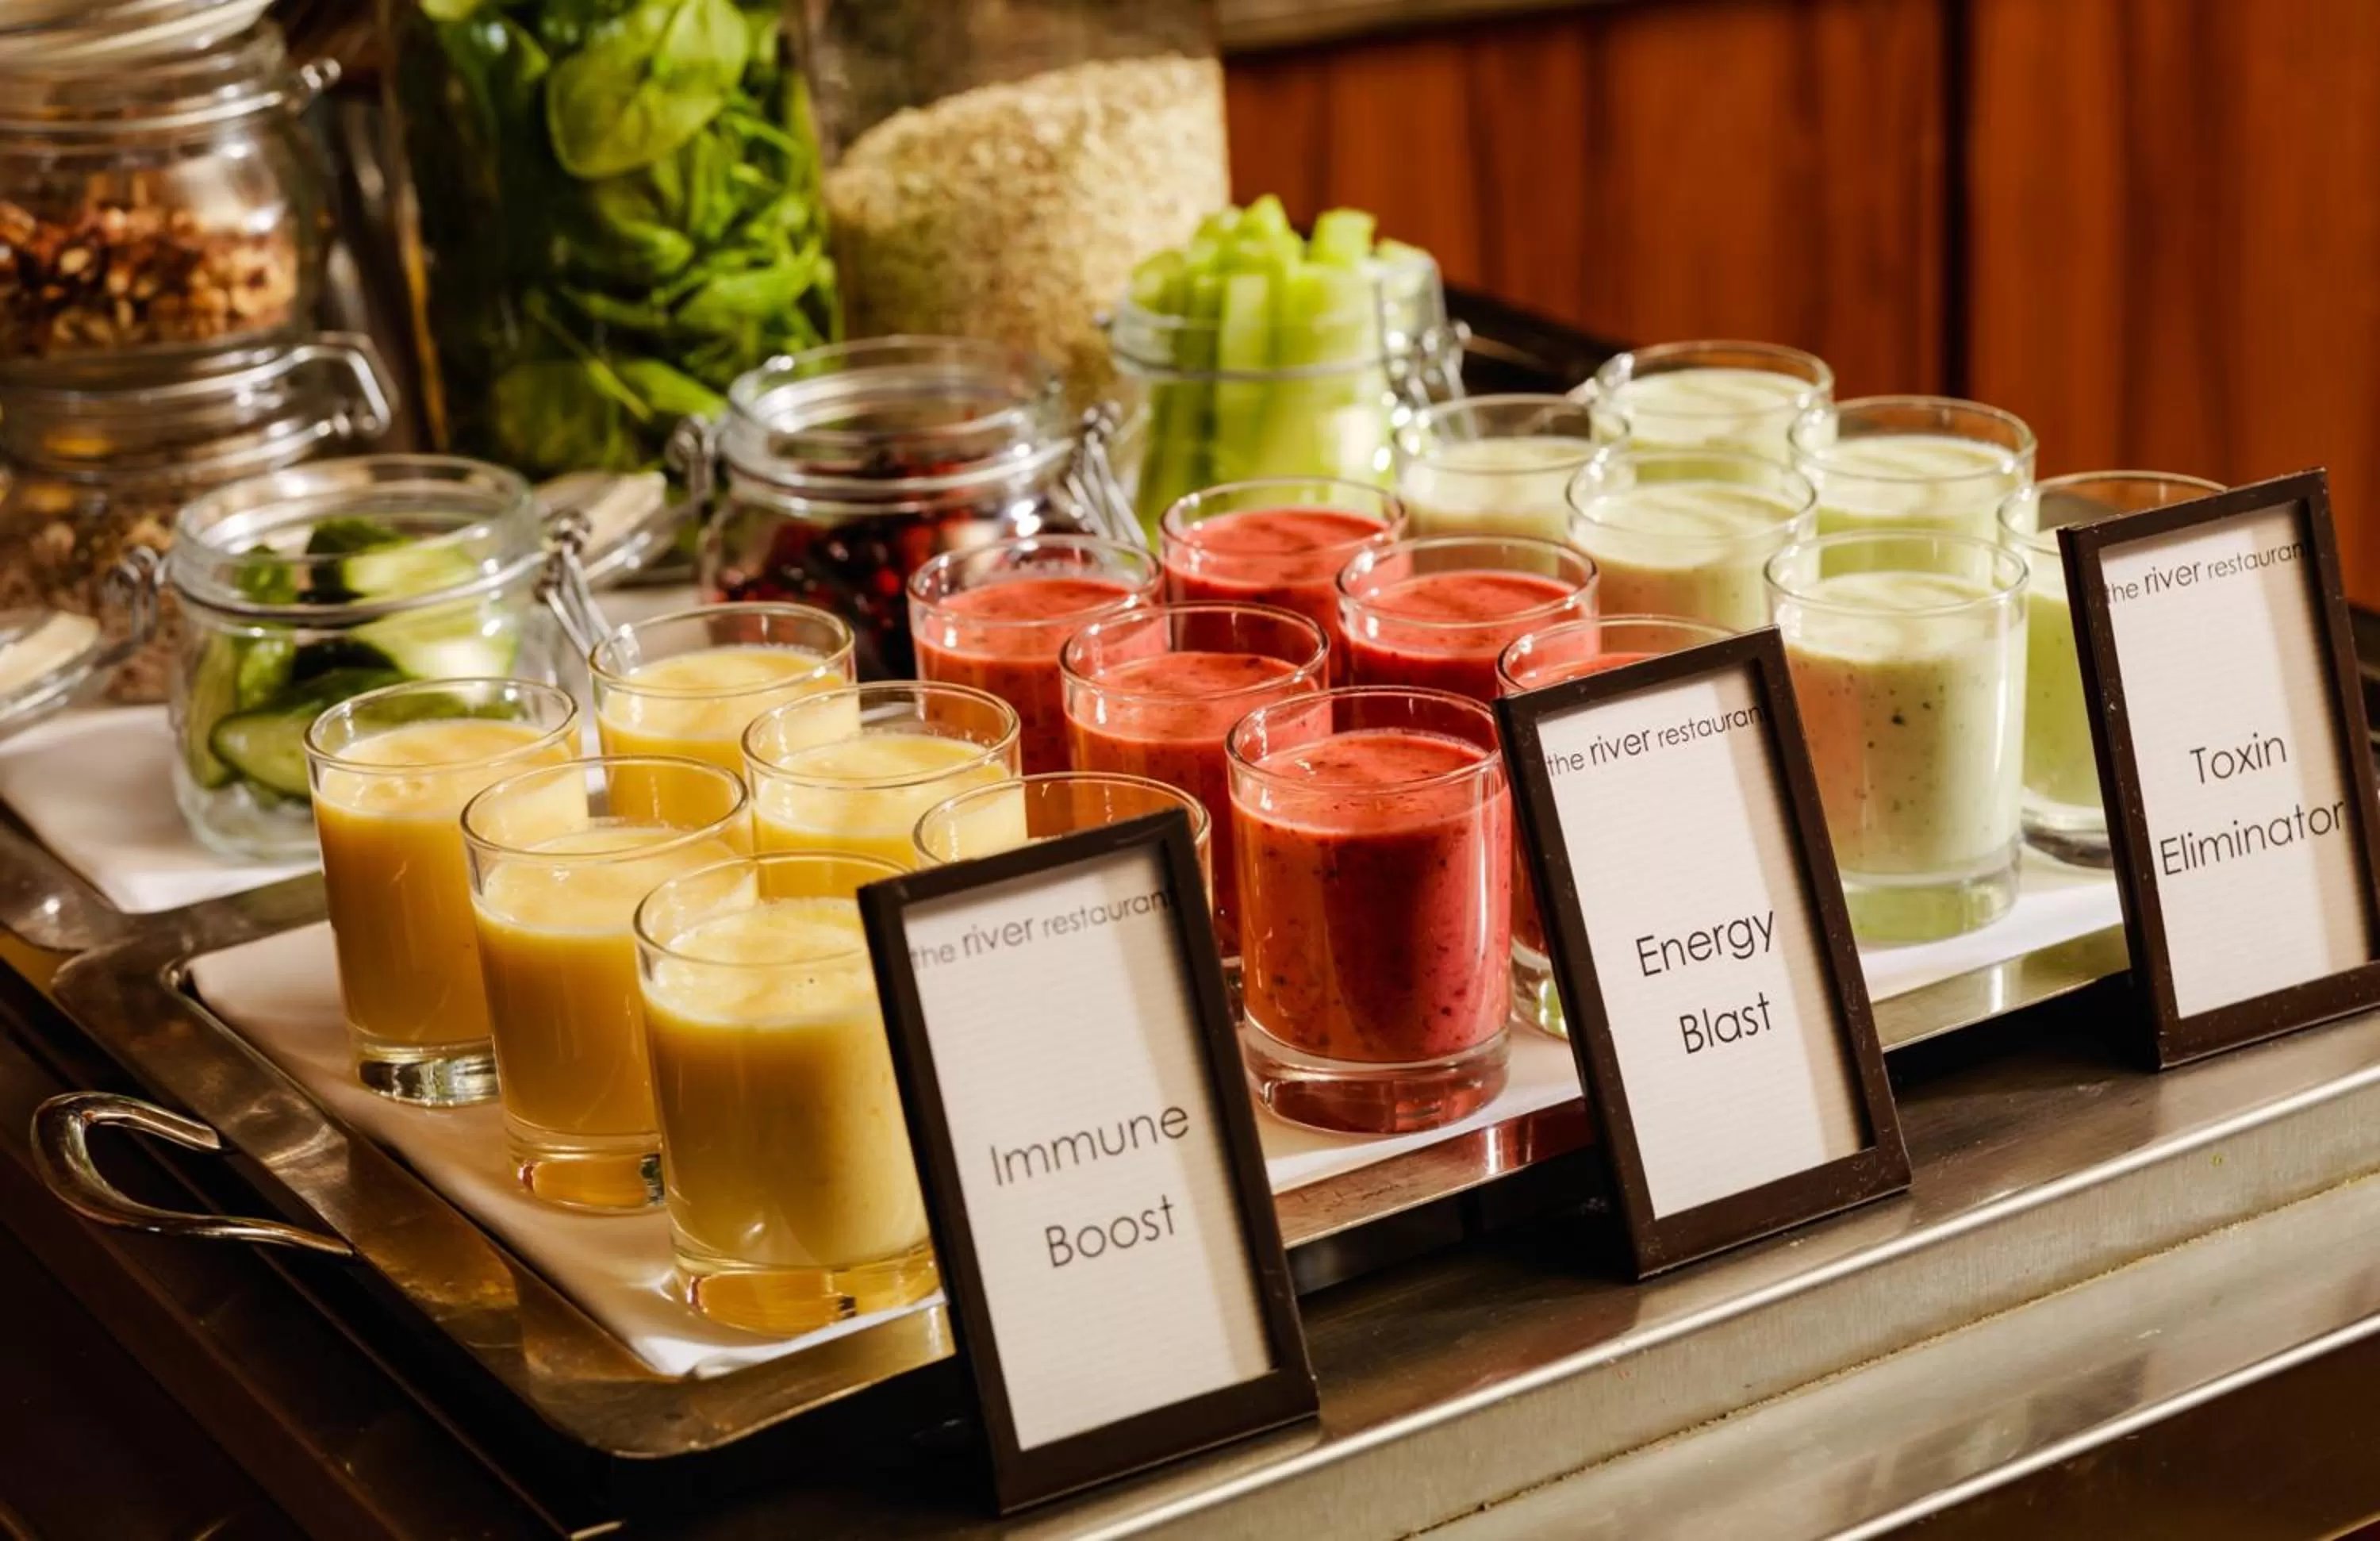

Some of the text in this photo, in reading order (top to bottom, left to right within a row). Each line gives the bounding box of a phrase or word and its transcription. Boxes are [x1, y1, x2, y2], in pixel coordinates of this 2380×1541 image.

[2144, 561, 2202, 595] river
[2206, 543, 2304, 581] restauran
[1546, 705, 1763, 777] the river restauran
[2190, 732, 2287, 784] Toxin
[2159, 800, 2345, 876] Eliminator
[961, 916, 1035, 959] river
[1042, 887, 1169, 938] restauran
[1636, 910, 1775, 978] Energy
[1679, 992, 1772, 1055] Blast
[990, 1105, 1189, 1187] Immune
[1045, 1194, 1175, 1268] Boost
